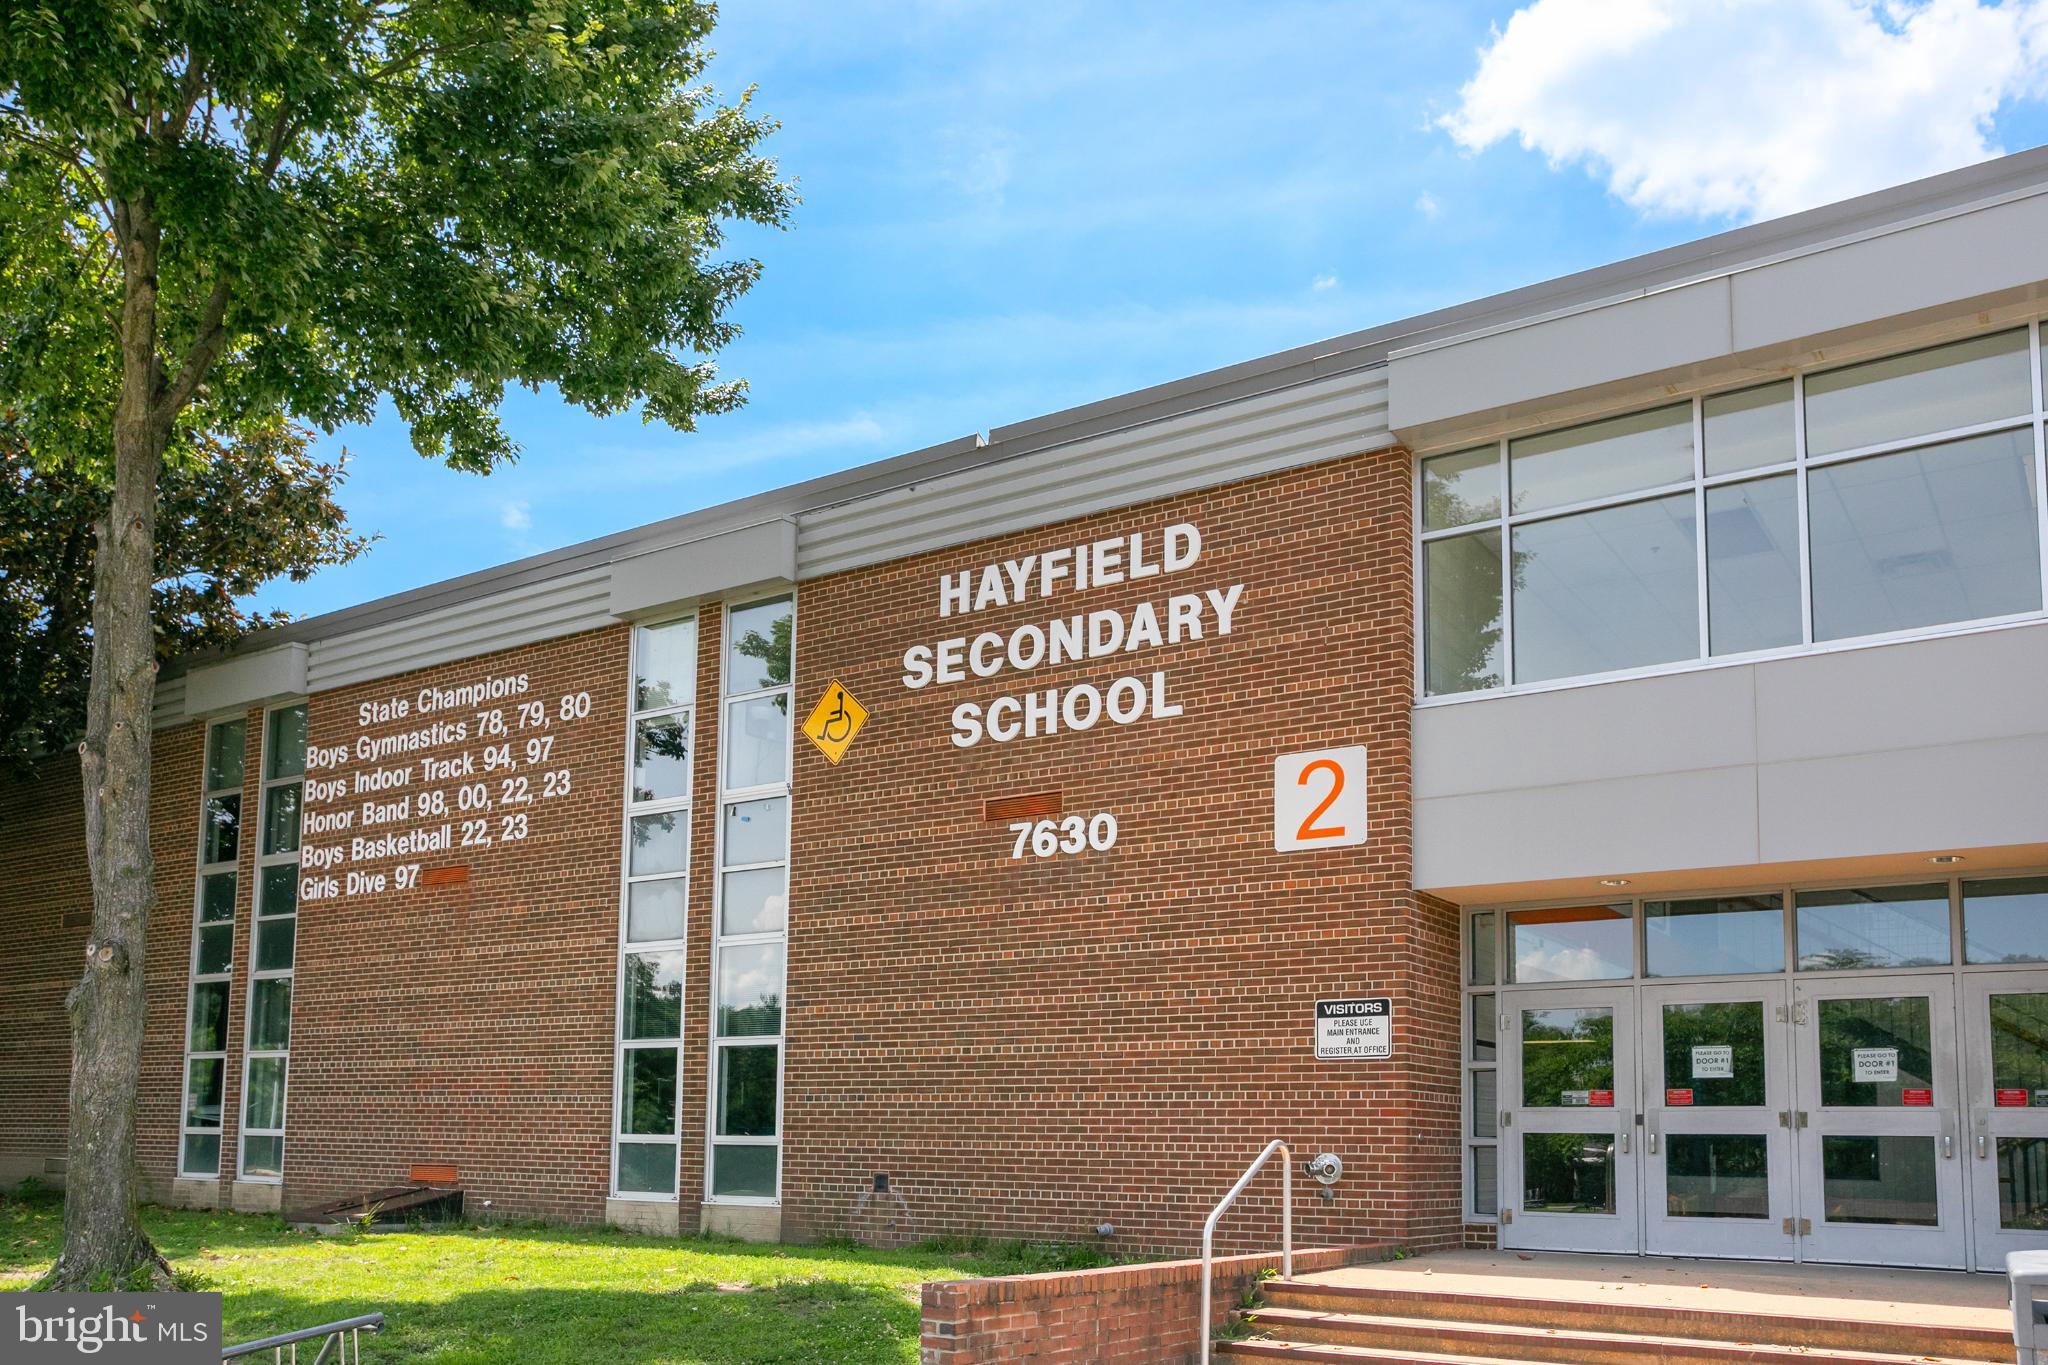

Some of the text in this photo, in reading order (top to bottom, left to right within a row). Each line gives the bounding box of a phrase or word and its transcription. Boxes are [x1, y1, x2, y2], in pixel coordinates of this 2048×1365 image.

[940, 524, 1202, 617] HAYFIELD
[902, 584, 1244, 689] SECONDARY
[307, 692, 590, 769] Boys Gymnastics 78, 79, 80
[359, 674, 528, 726] State Champions
[951, 671, 1183, 747] SCHOOL
[303, 770, 571, 834] Honor Band 98, 00, 22, 23
[305, 736, 554, 803] Boys Indoor Track 94, 97
[1296, 759, 1345, 840] 2
[302, 814, 528, 869] Boys Basketball 22, 23
[1010, 813, 1118, 859] 7630
[301, 864, 419, 900] Girls Dive 97
[1324, 1003, 1382, 1014] VISITORS
